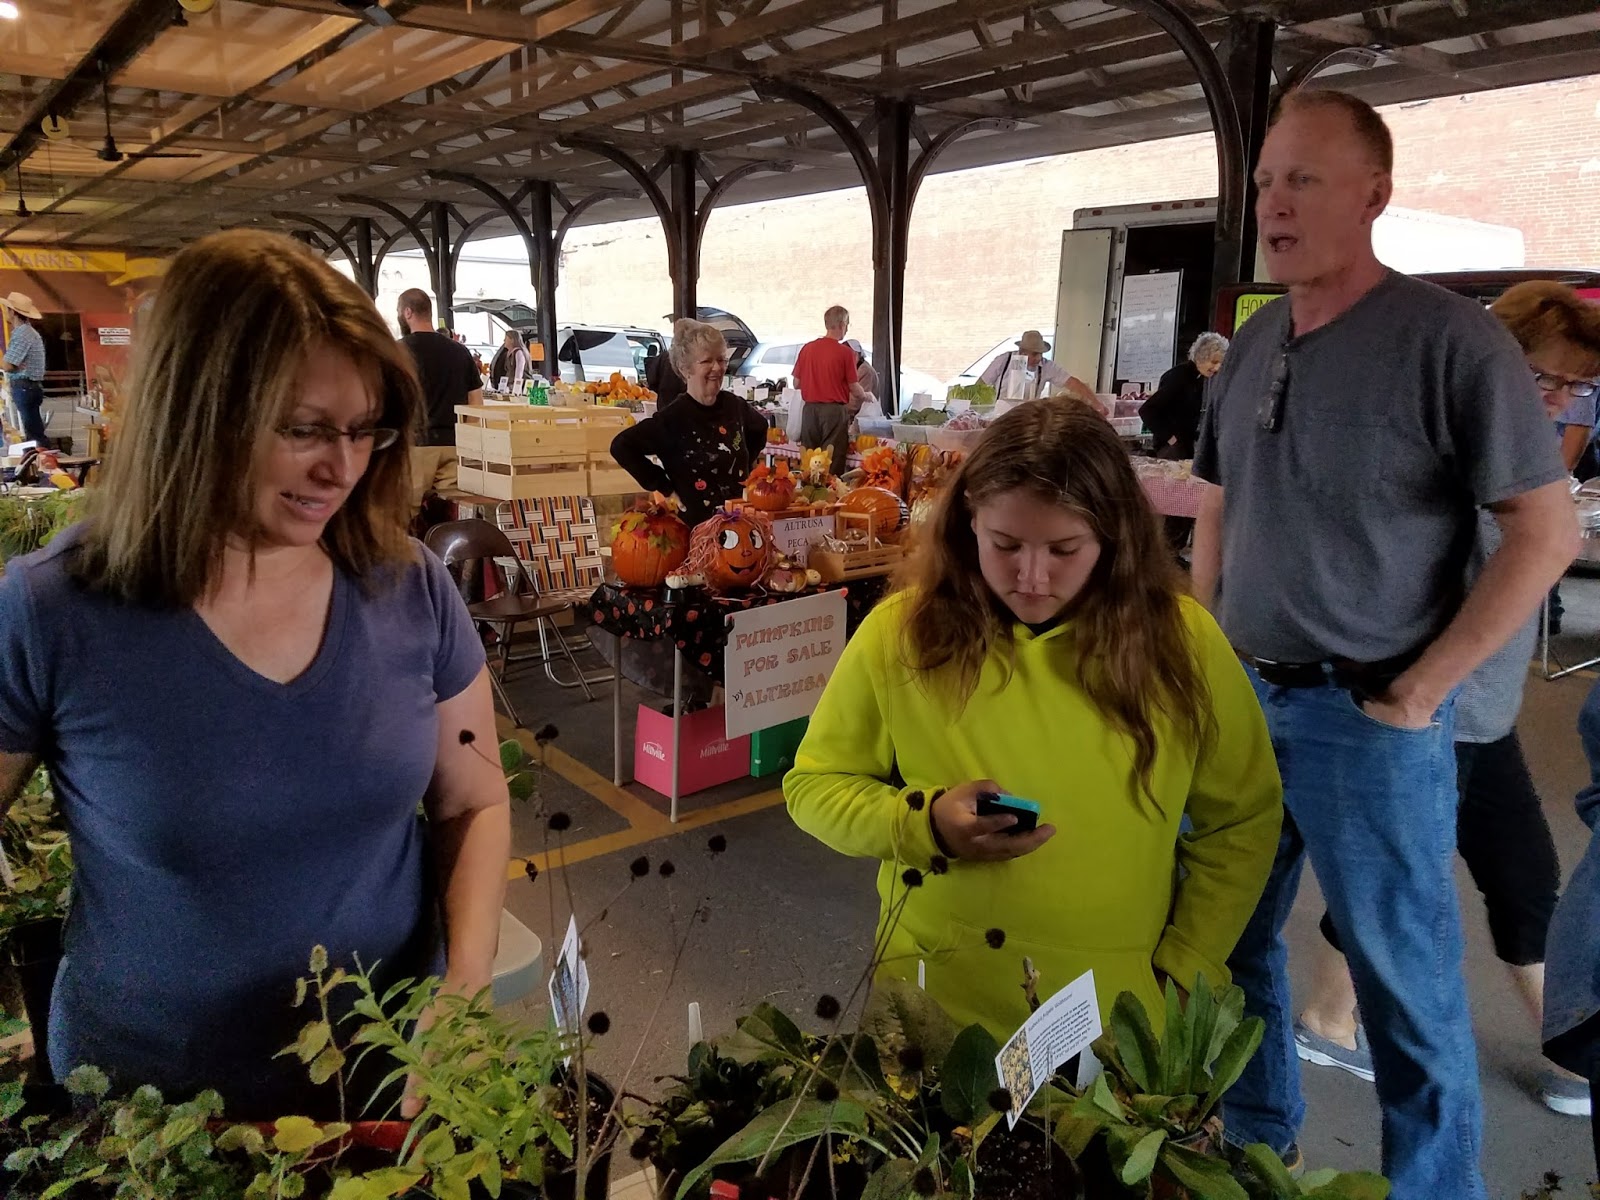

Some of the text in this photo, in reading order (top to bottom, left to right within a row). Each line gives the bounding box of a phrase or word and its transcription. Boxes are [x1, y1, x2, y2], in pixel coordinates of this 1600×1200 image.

[2, 252, 88, 268] MARKET
[784, 518, 824, 531] ALTRUSA
[787, 537, 809, 548] PECA
[735, 614, 834, 651] PUMPKINS
[743, 640, 832, 677] FOR SALE
[732, 672, 828, 708] by ALTRUSA
[643, 743, 665, 760] Millville
[700, 743, 730, 759] Millville
